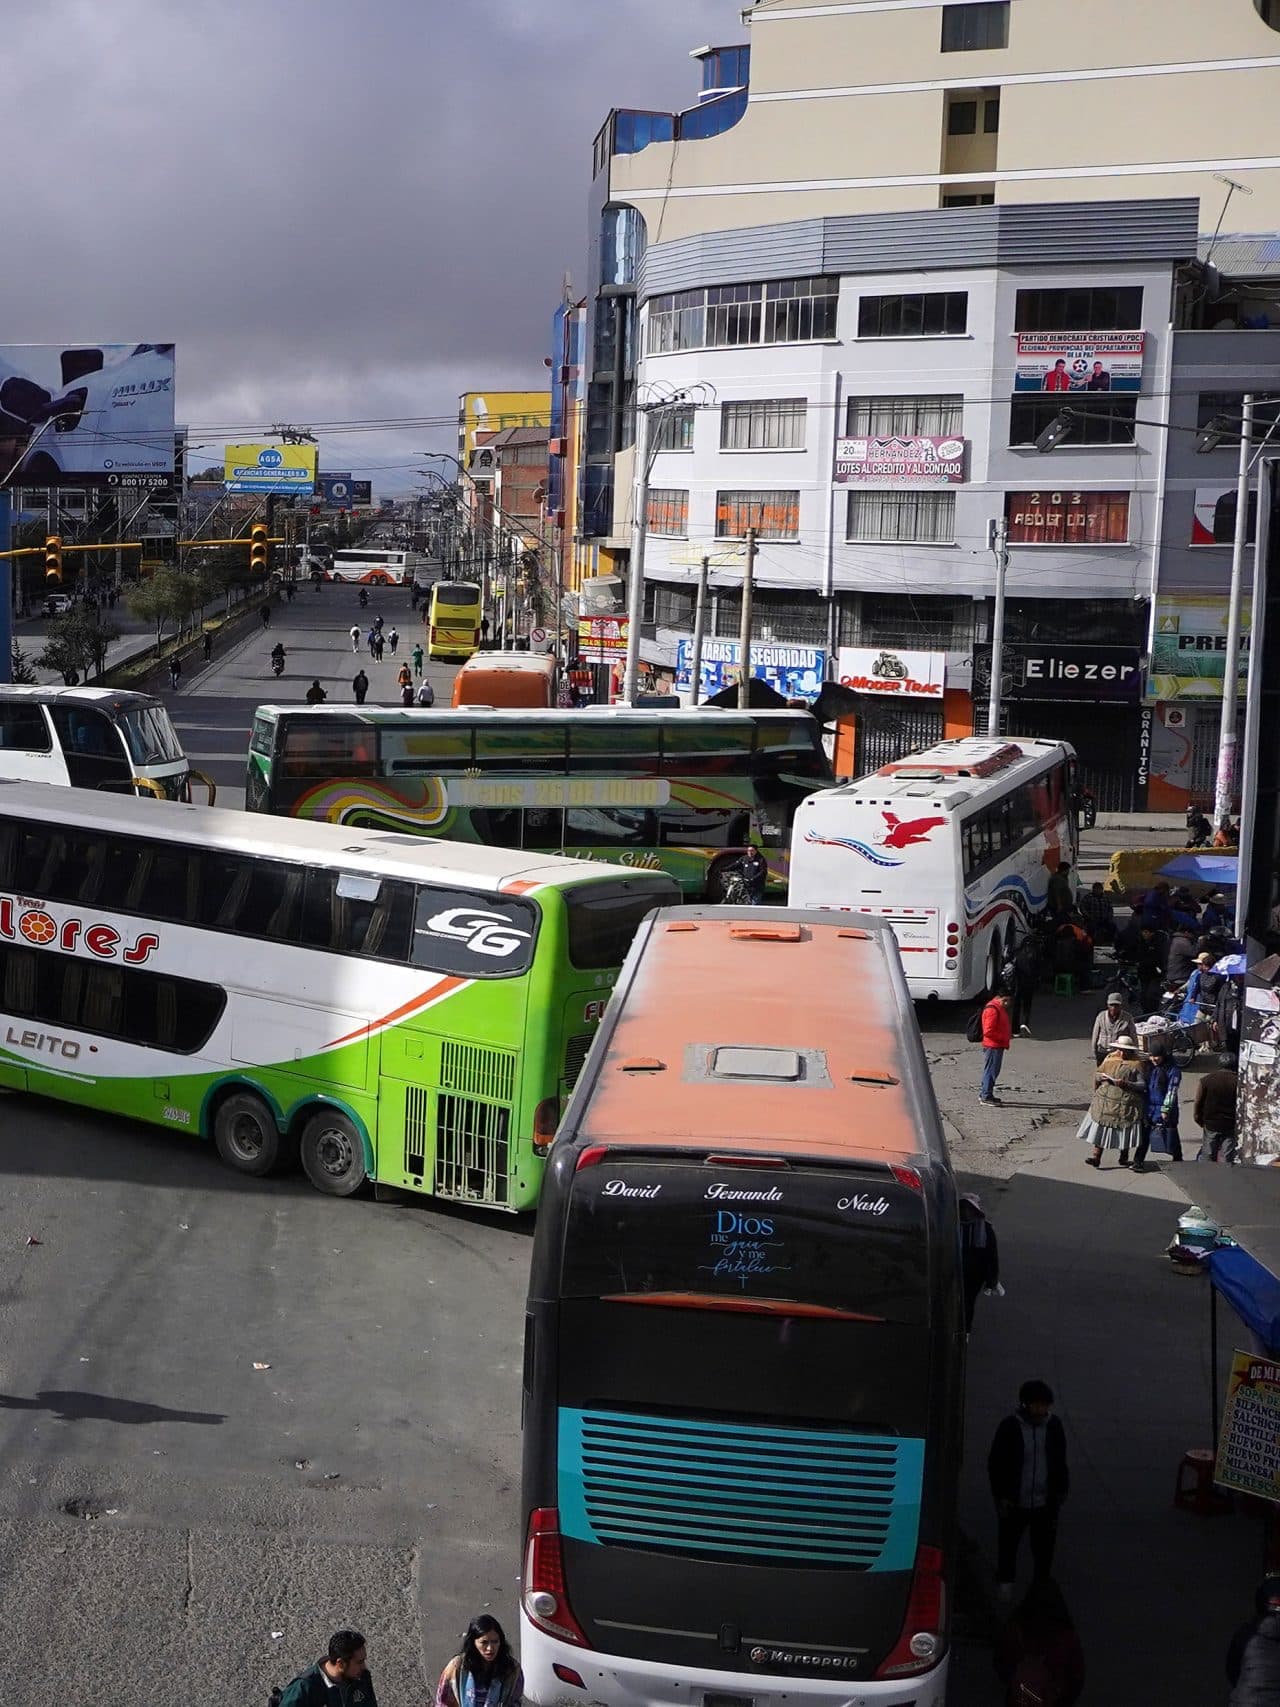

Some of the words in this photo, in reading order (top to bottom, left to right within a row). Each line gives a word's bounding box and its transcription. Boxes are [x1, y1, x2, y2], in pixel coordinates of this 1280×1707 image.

[1021, 334, 1048, 342] PARTIDO
[843, 446, 854, 455] 20
[868, 449, 920, 459] HERNANDEZ
[837, 463, 861, 474] LOTES
[861, 463, 871, 474] AL
[872, 463, 905, 474] CREDITO
[906, 463, 912, 473] Y
[913, 463, 923, 474] AL
[924, 463, 961, 474] CONTADO
[121, 478, 137, 486] 800
[138, 478, 146, 486] 17
[148, 478, 168, 486] 5200
[749, 649, 816, 669] SEGURIDAD
[1026, 658, 1135, 681] Eliezer
[903, 679, 942, 694] TRAC
[6, 1027, 81, 1059] LEITO
[602, 1180, 662, 1199] David
[703, 1183, 784, 1202] Fernanda
[837, 1193, 890, 1216] Nasly
[717, 1210, 774, 1236] Dios
[711, 1233, 728, 1243] me
[738, 1250, 746, 1260] y
[748, 1250, 766, 1260] me
[1250, 1365, 1263, 1380] DE
[1238, 1385, 1263, 1403] SOPA
[1231, 1420, 1277, 1444] TORTILLA
[1229, 1432, 1262, 1451] HUEVO
[1227, 1444, 1261, 1463] HUEVO
[1225, 1456, 1275, 1481] MILANESA
[771, 1650, 858, 1668] Marcopolo
